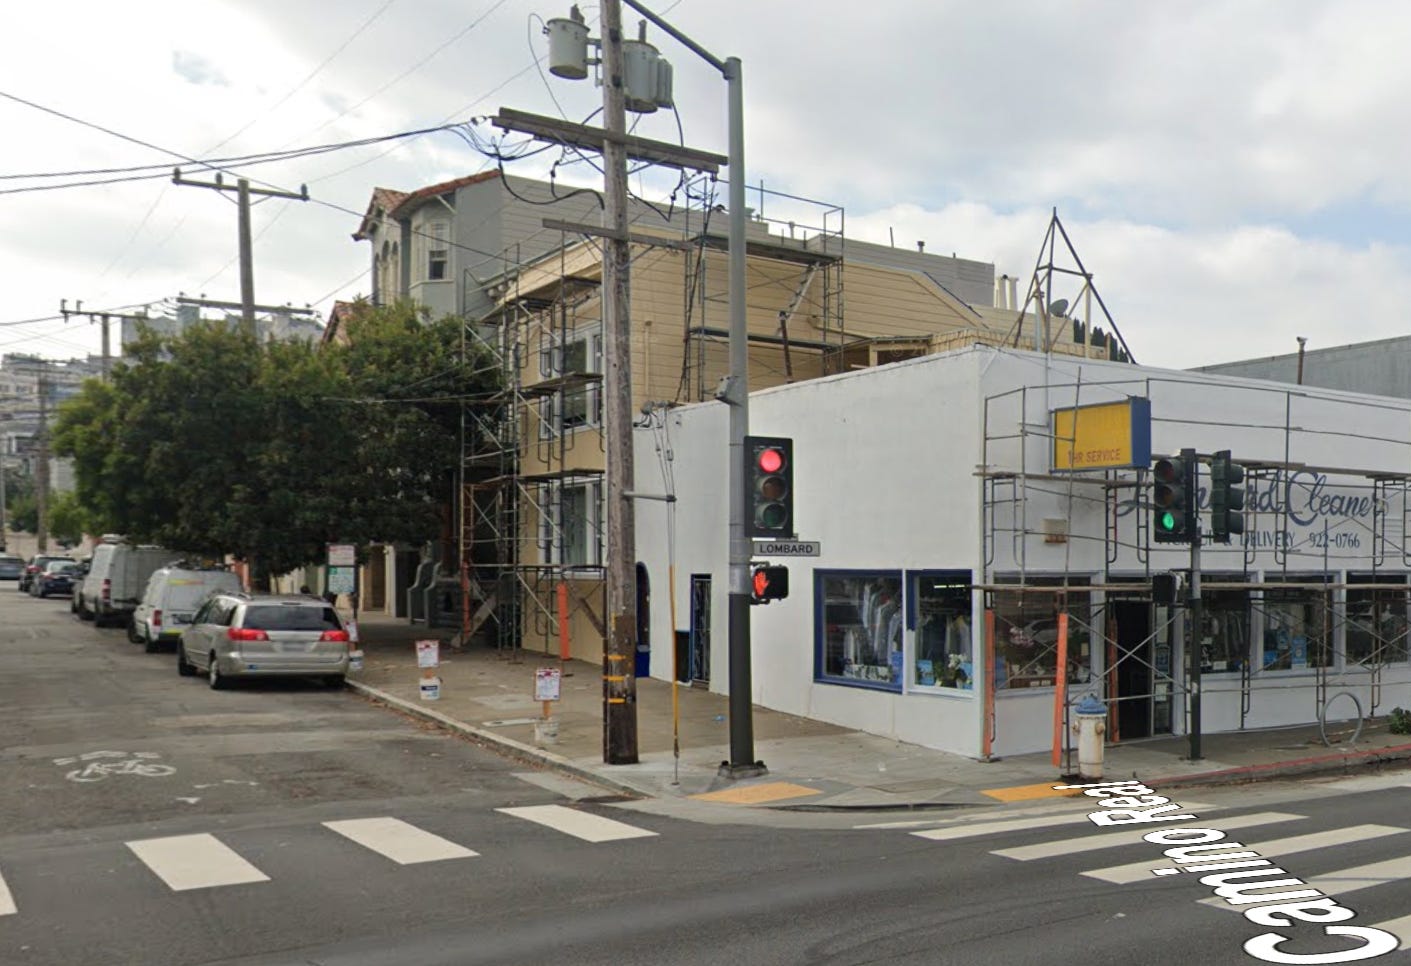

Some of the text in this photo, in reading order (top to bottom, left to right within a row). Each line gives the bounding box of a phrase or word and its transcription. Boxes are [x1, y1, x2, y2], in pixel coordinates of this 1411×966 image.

[1086, 449, 1121, 463] SERVICE
[1240, 531, 1295, 547] DELIVERY
[1309, 531, 1360, 548] 922-0766
[760, 544, 813, 554] LOMBARD
